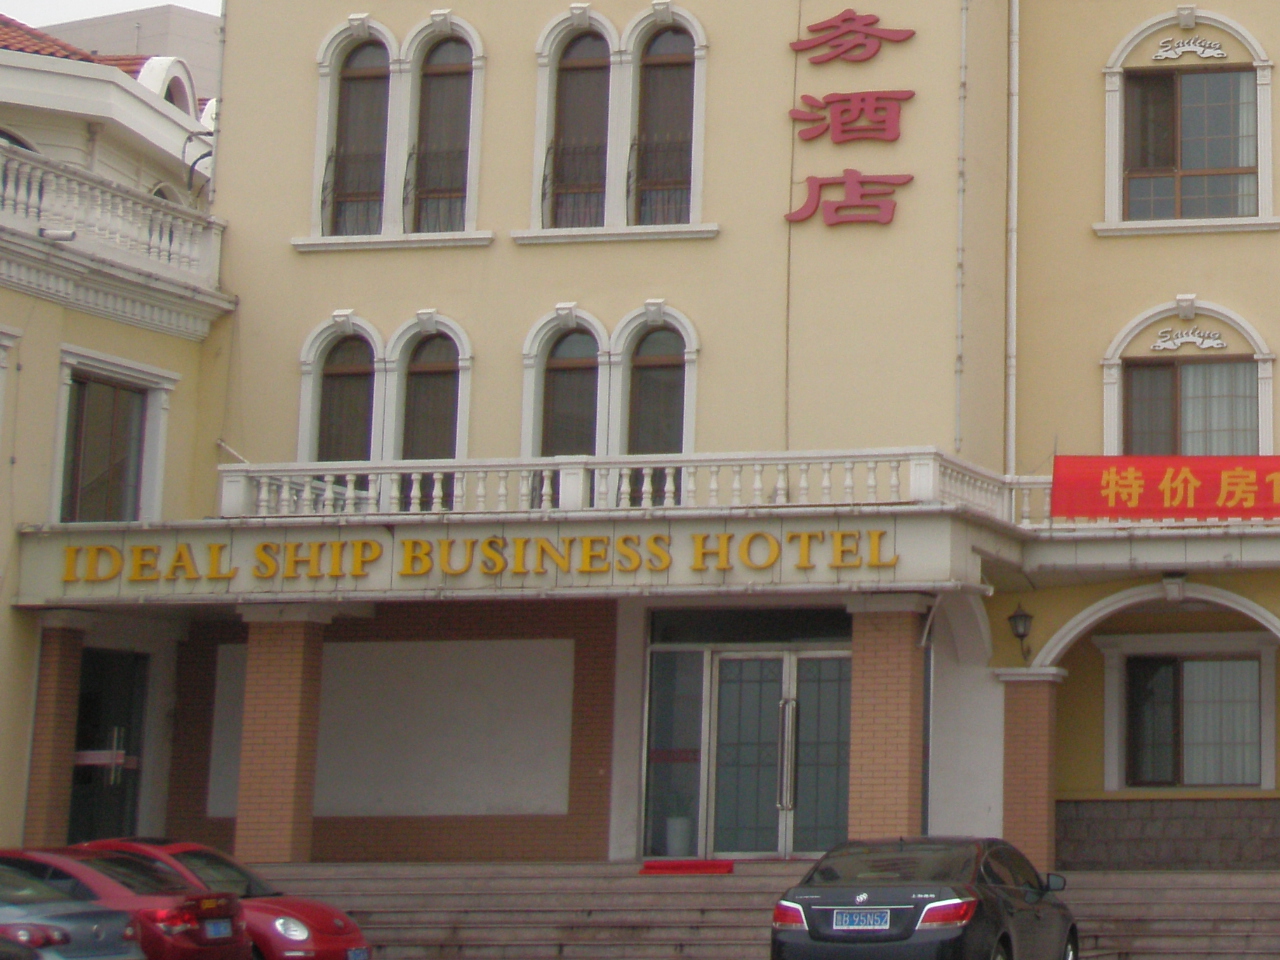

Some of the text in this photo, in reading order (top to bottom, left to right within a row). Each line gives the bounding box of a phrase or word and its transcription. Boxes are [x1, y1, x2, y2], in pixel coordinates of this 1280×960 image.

[62, 530, 900, 582] IDEAL SHIP BUSINESS HOTEL
